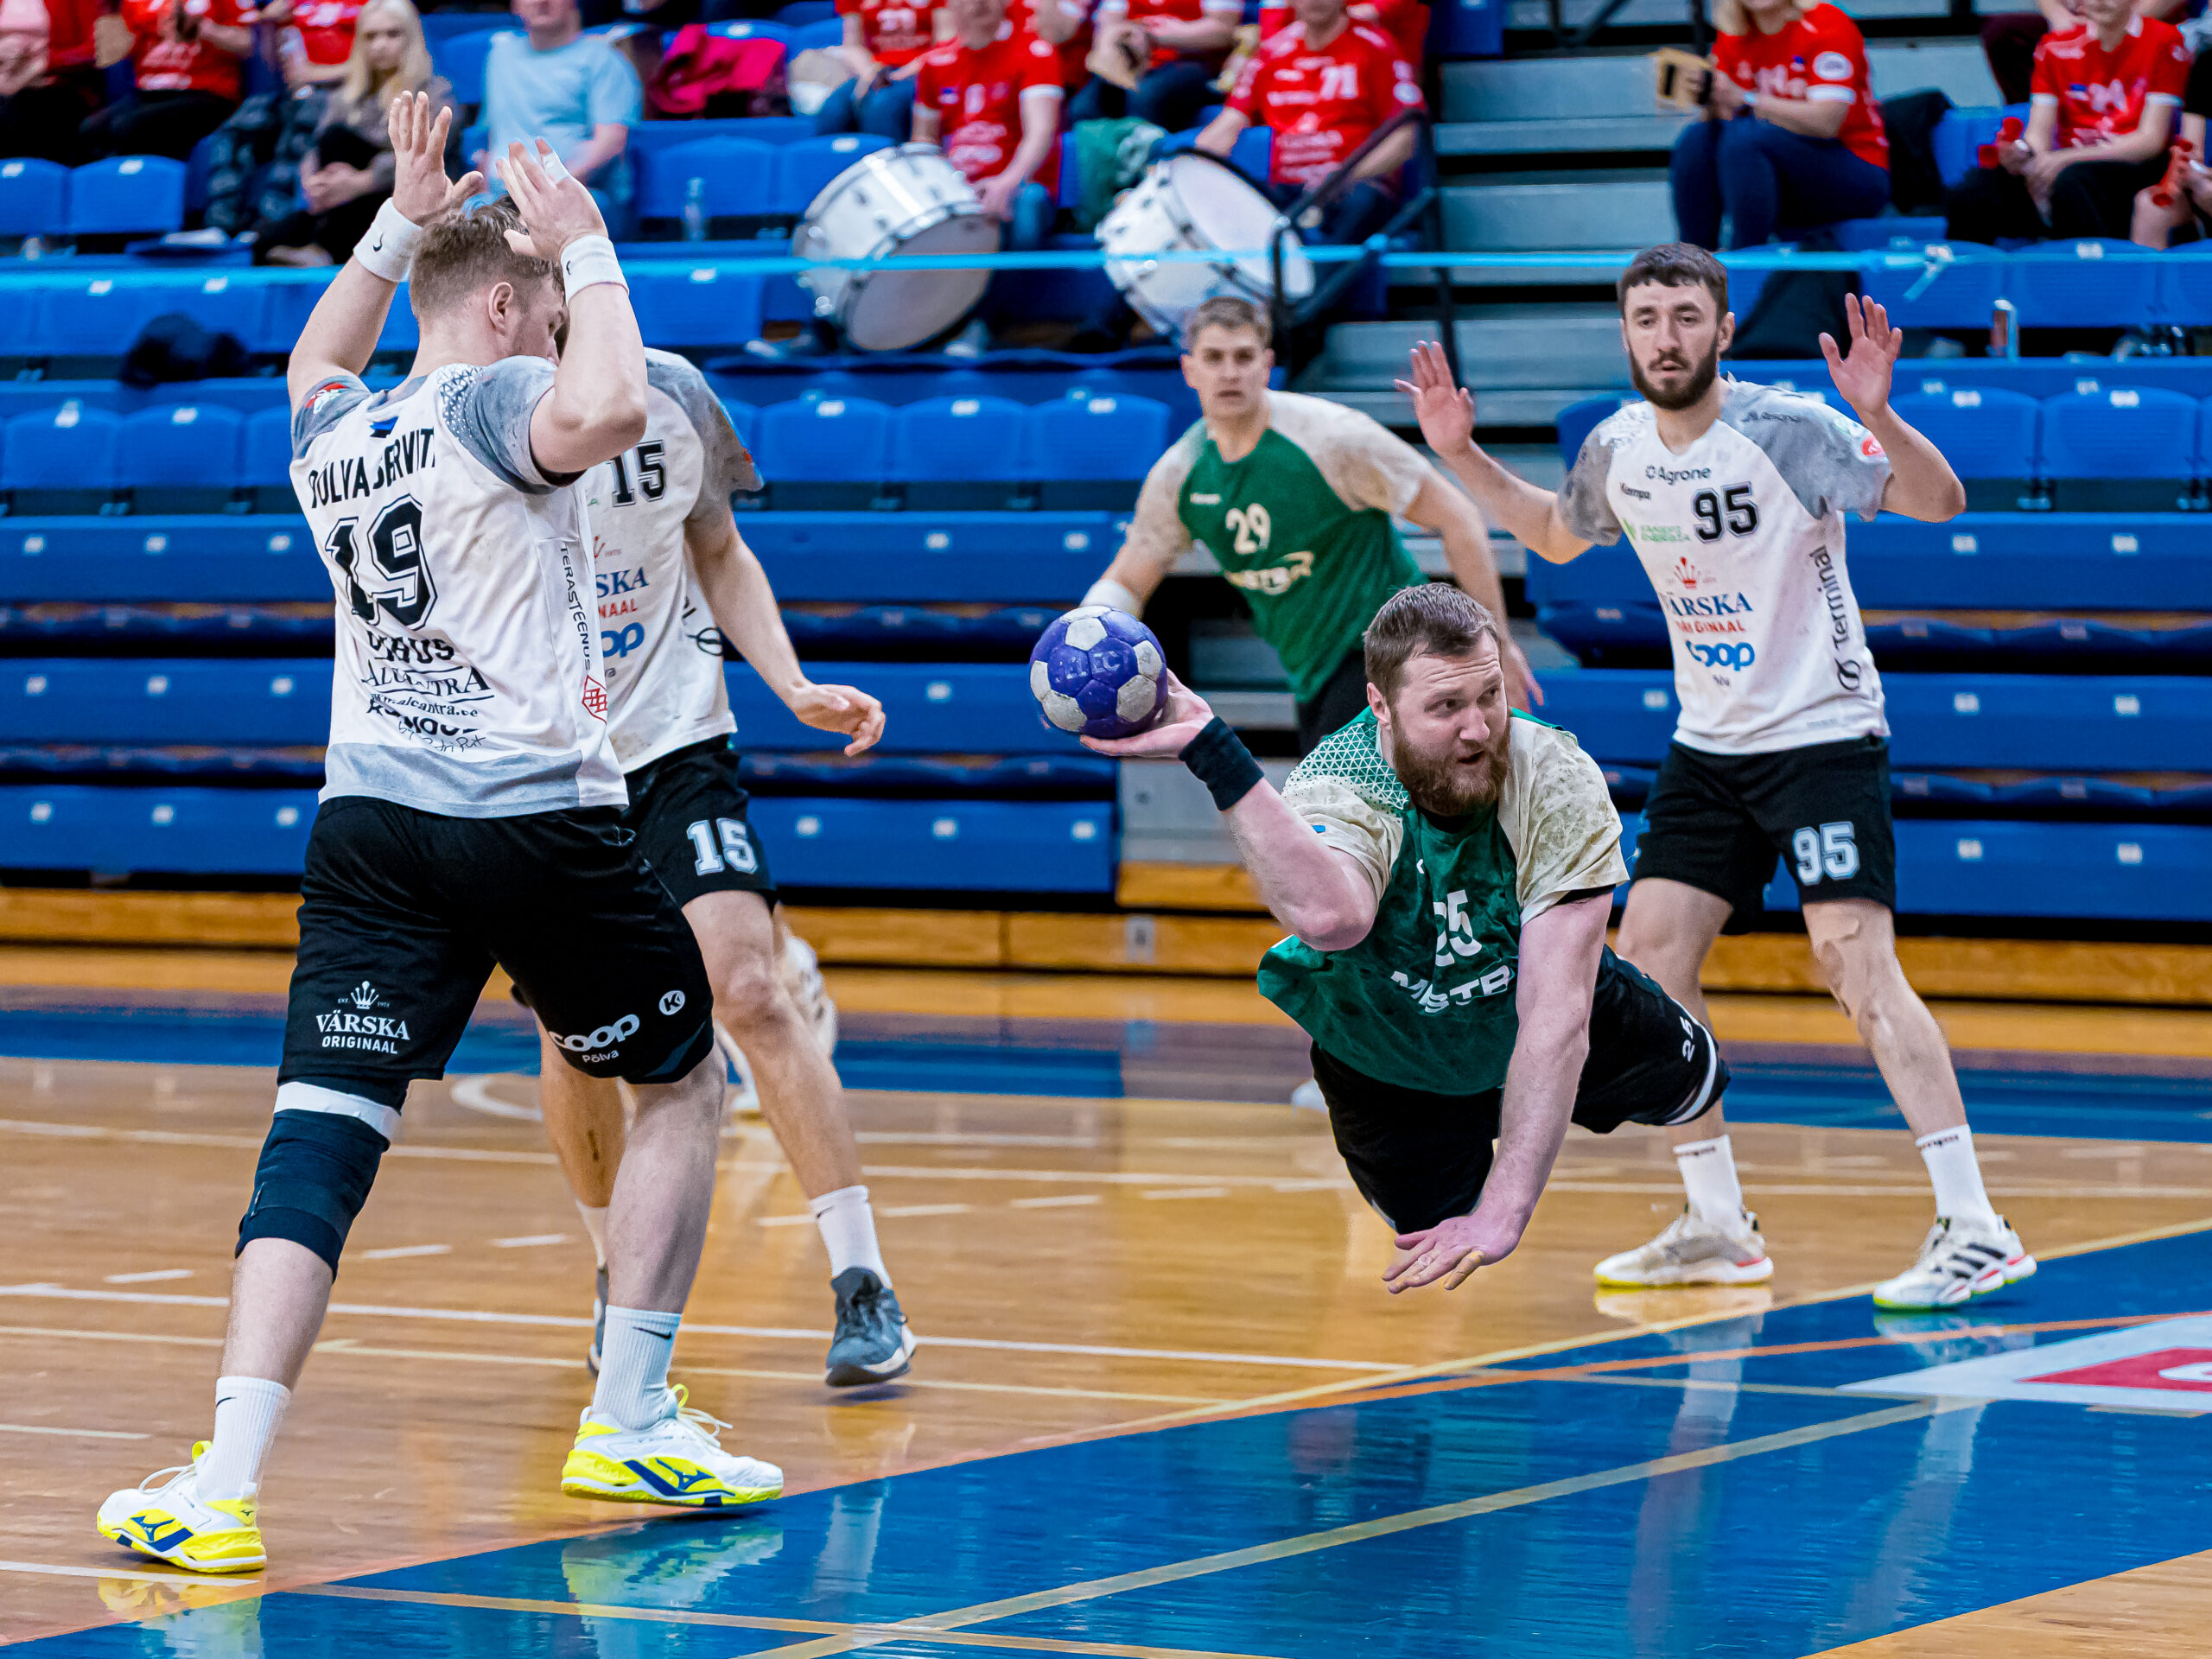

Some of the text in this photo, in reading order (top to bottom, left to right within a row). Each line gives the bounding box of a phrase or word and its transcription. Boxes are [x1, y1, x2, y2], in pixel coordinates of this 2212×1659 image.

[606, 439, 665, 508] 15
[1225, 503, 1271, 555] 29
[1690, 480, 1760, 544] 95
[325, 493, 438, 632] 19
[596, 566, 650, 599] SKA
[561, 543, 591, 672] TERASTEENUS
[598, 598, 639, 619] NAAL
[1809, 543, 1850, 652] Terminal
[601, 621, 645, 658] op
[686, 817, 760, 876] 15
[1792, 821, 1859, 887] 95
[315, 1009, 410, 1041] VÄRSKA
[321, 1035, 398, 1055] ORIGINAAL
[549, 1014, 640, 1052] coop
[582, 1050, 620, 1063] Põlva
